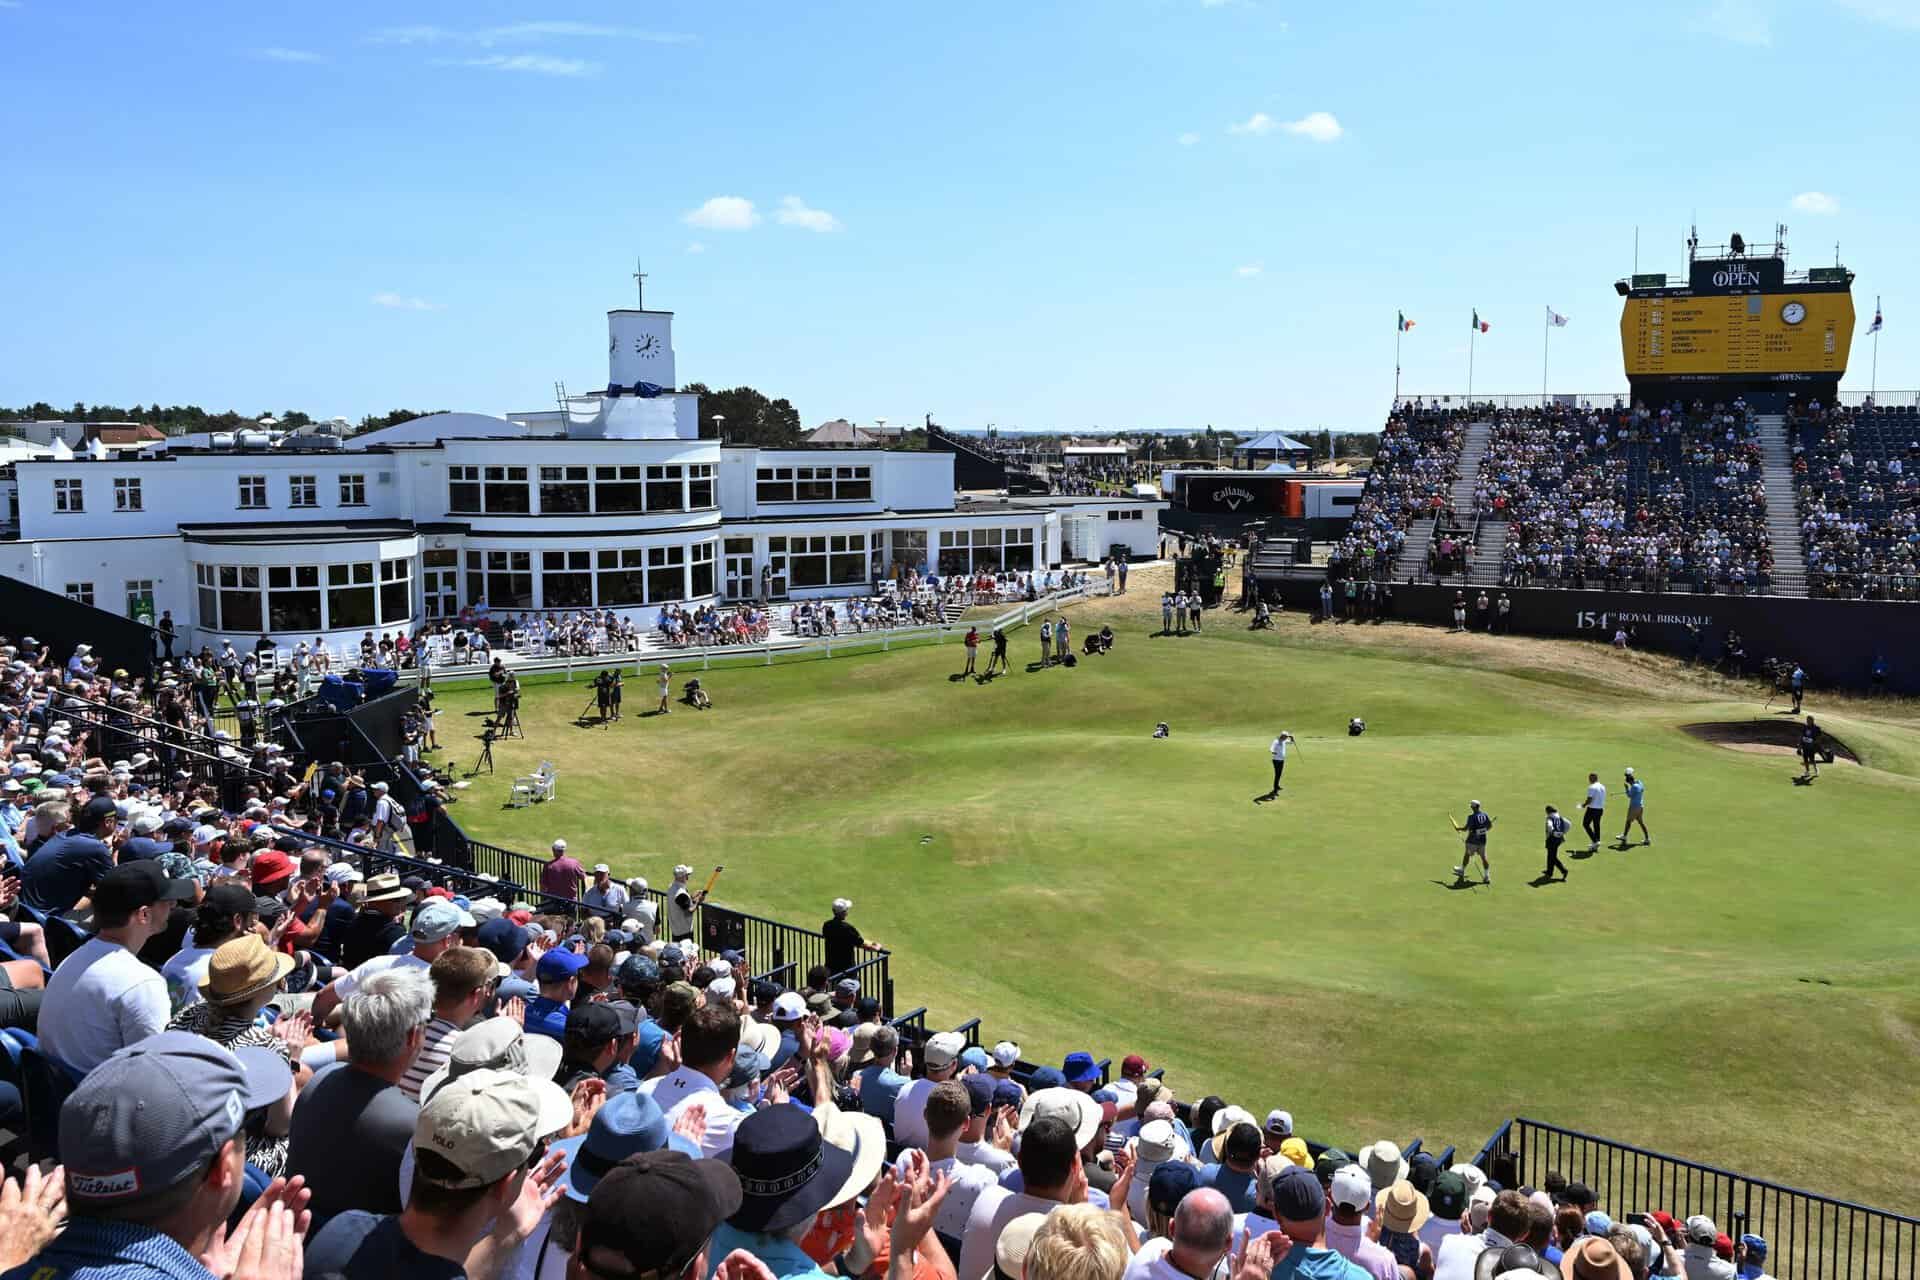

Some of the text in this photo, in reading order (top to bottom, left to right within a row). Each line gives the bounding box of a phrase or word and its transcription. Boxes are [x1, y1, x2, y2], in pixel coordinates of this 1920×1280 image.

[1728, 263, 1747, 272] THE
[1712, 271, 1761, 287] OPEN
[1212, 486, 1255, 502] Callaway
[1618, 612, 1653, 623] ROYAL
[1657, 614, 1713, 625] BIRKDALE
[432, 1134, 454, 1150] POLO
[72, 1175, 134, 1193] Titleist
